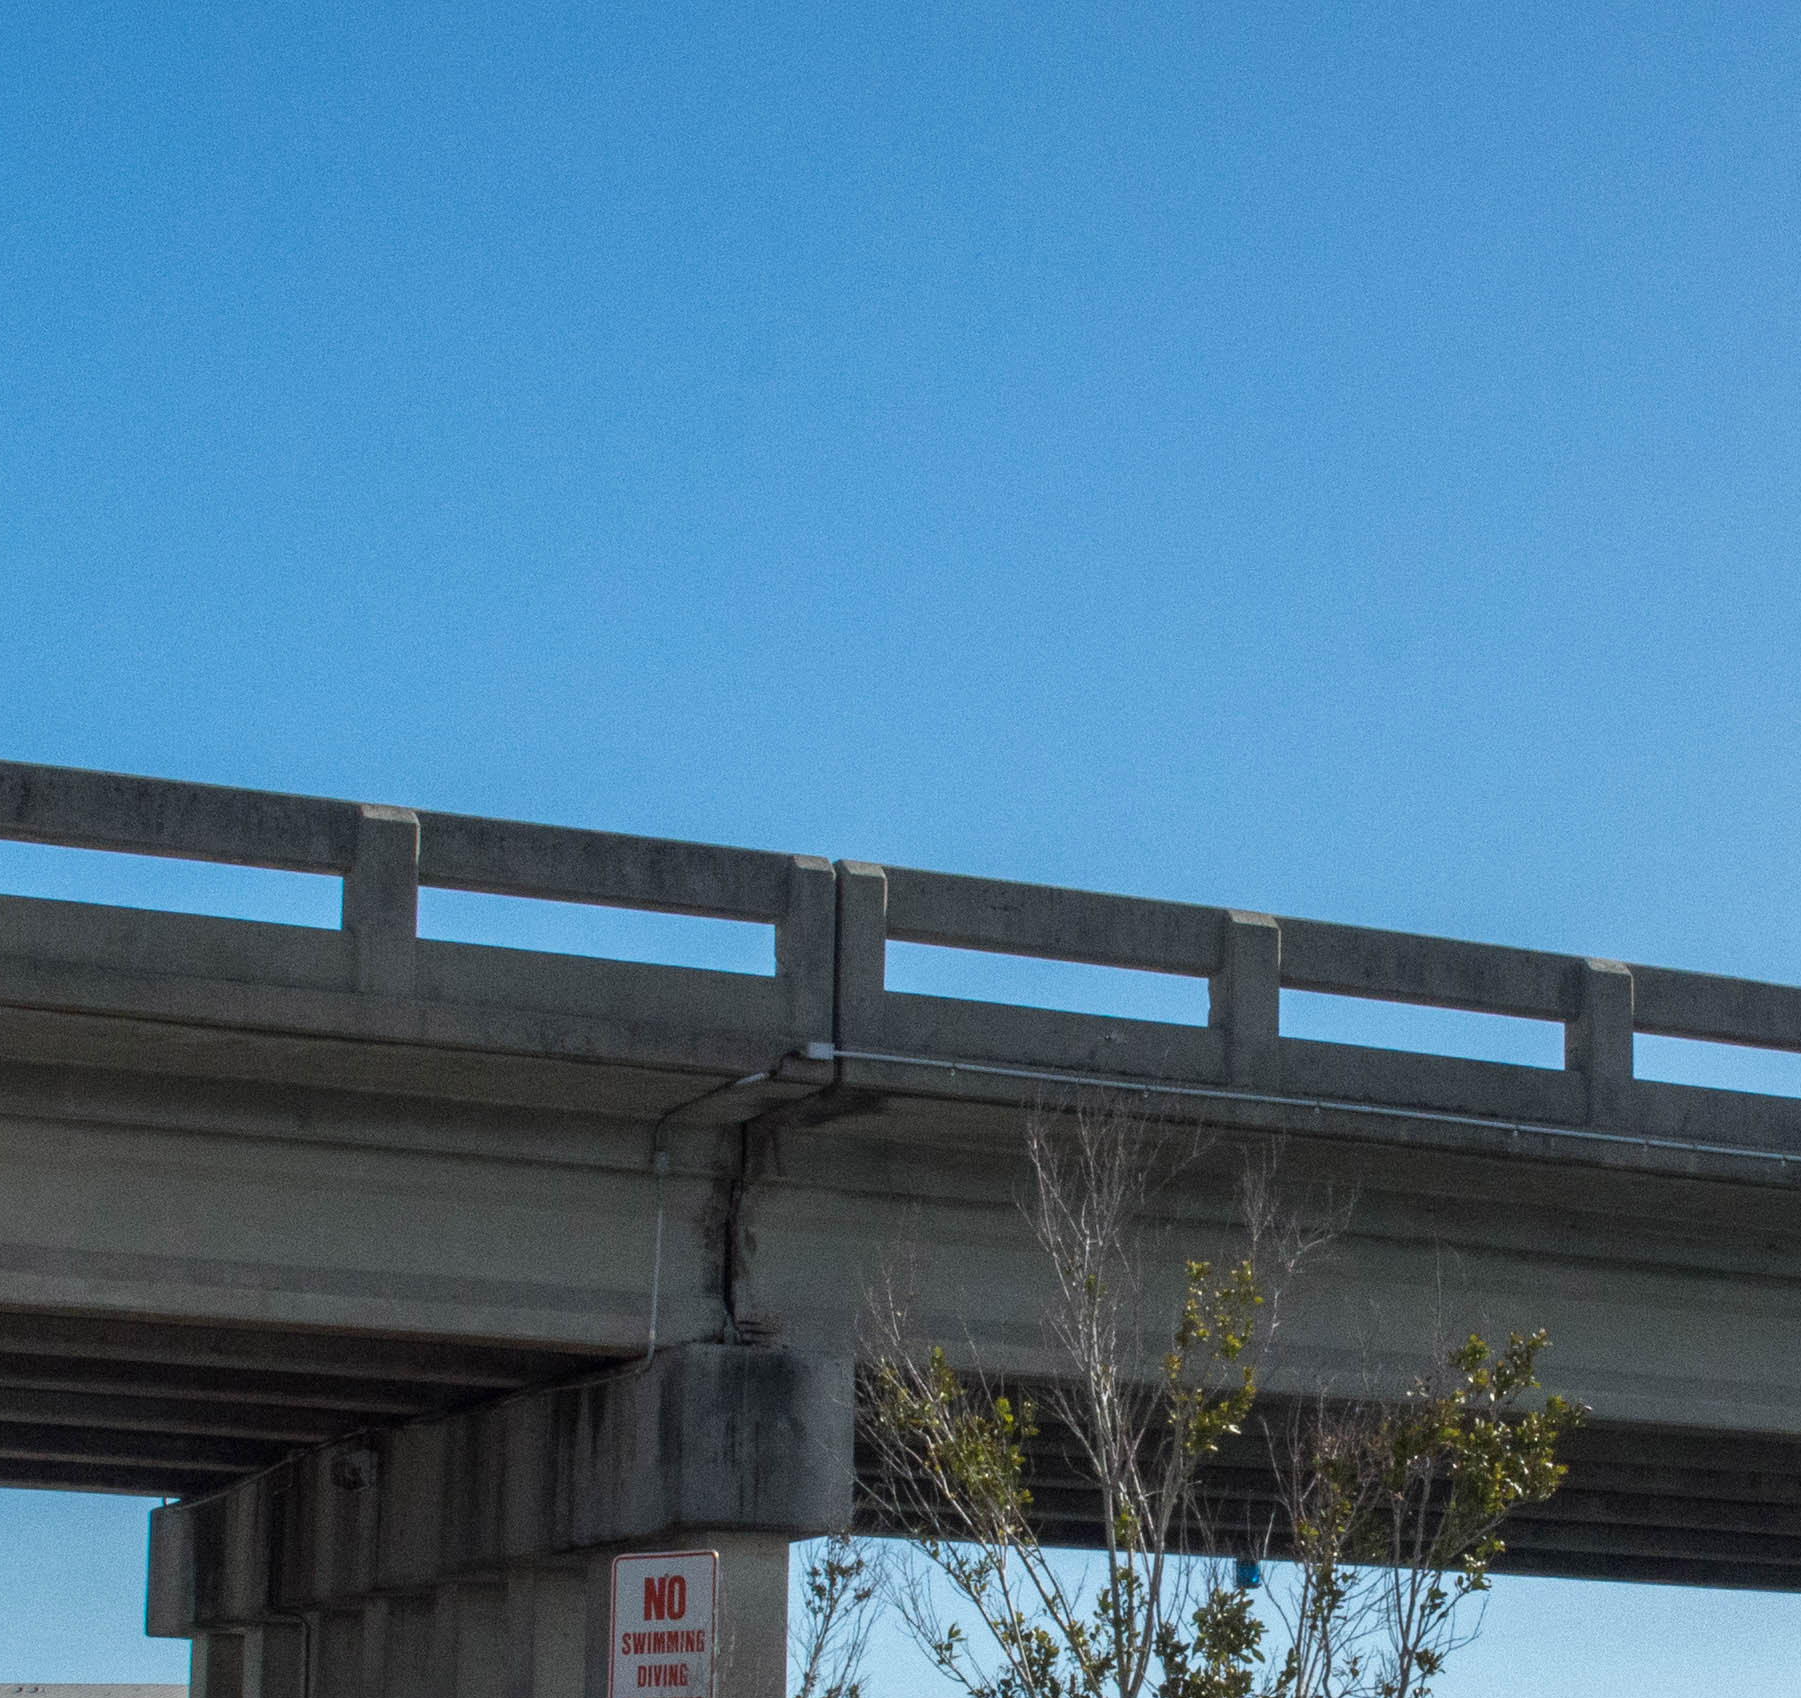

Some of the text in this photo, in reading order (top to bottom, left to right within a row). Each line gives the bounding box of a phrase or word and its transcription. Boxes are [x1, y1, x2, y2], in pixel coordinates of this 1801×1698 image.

[643, 1575, 687, 1621] NO
[621, 1630, 705, 1656] SWIMMING
[637, 1664, 688, 1688] DIVING
